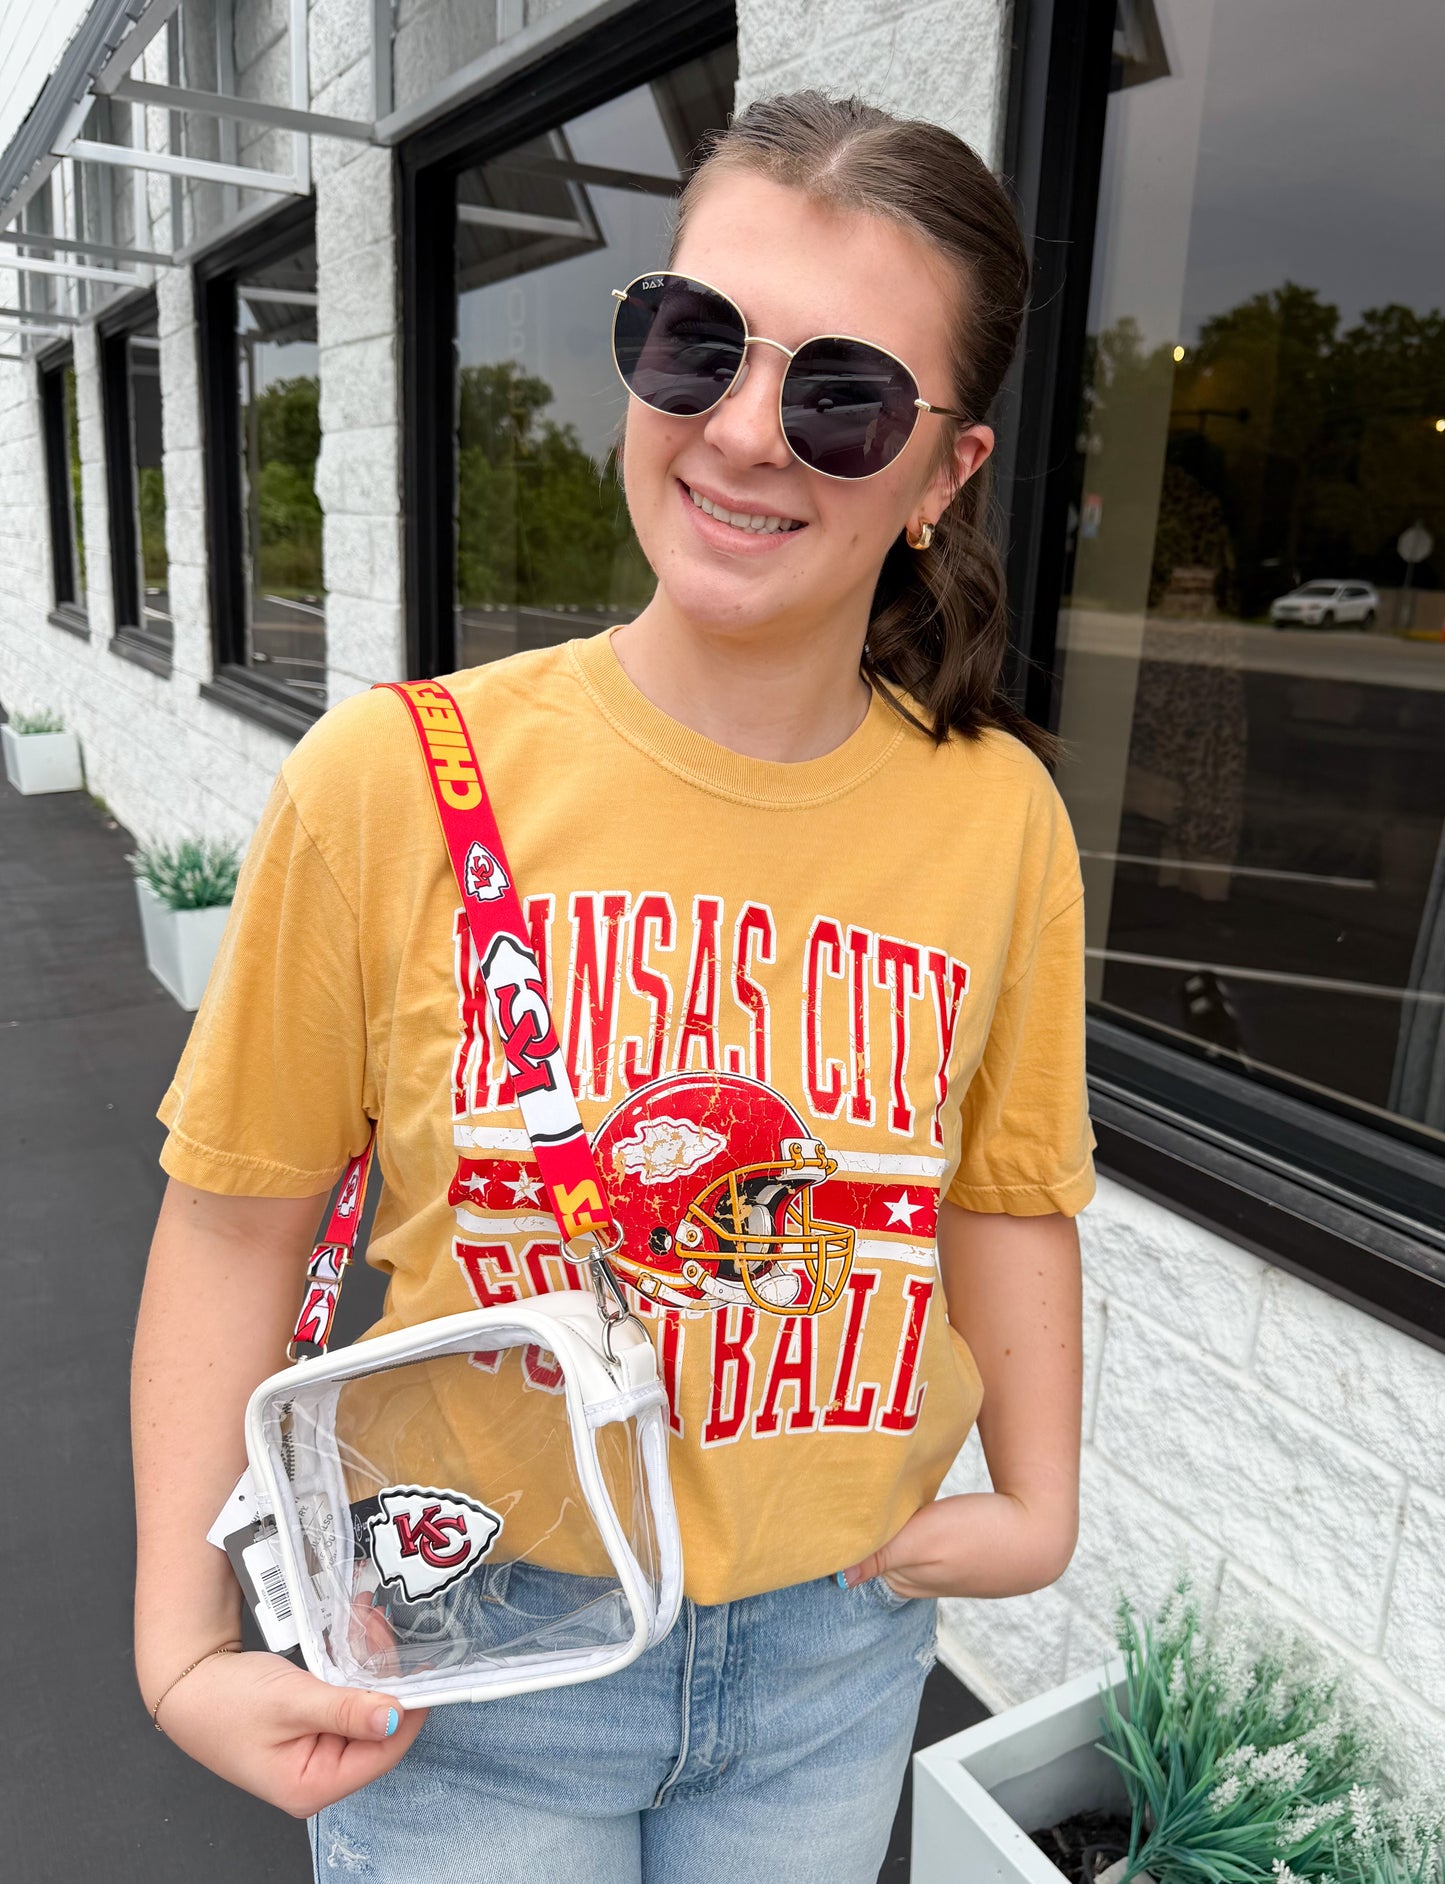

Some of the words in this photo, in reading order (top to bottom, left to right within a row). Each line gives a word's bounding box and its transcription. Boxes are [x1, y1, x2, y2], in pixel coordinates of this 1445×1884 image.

[642, 278, 665, 290] DAX
[470, 853, 495, 889] KC
[803, 914, 972, 1148] CITY
[452, 1235, 937, 1449] FOTBALL
[393, 1504, 472, 1569] KC
